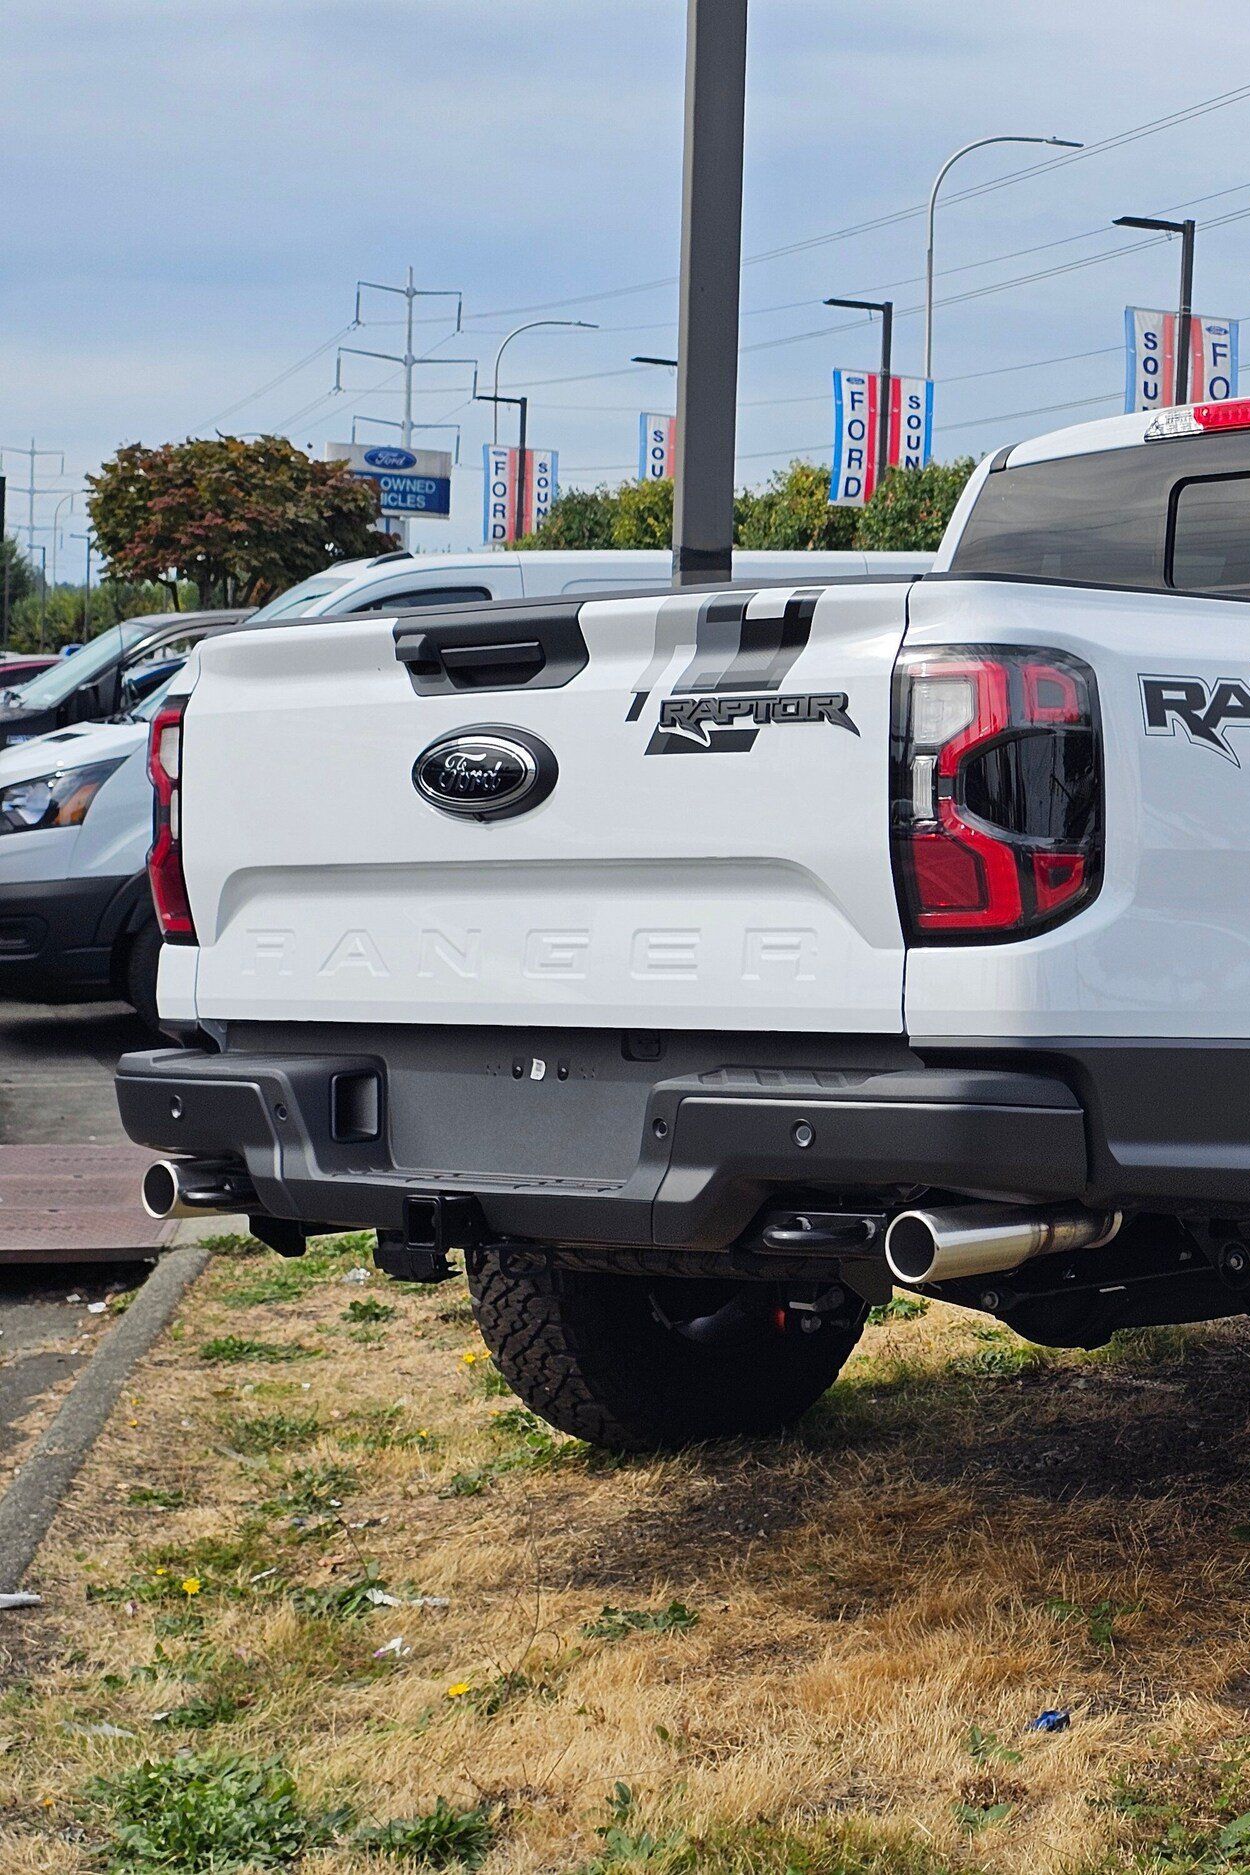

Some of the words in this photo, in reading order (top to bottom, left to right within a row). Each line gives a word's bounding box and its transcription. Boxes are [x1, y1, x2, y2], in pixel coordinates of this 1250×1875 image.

[1142, 332, 1158, 409] SOU
[1209, 342, 1230, 401] FO
[374, 451, 406, 466] Ford
[651, 430, 665, 478] SOU
[843, 391, 865, 498] FORD
[905, 395, 922, 470] SOUN
[380, 493, 426, 509] ICLES
[492, 461, 507, 540] FORD
[660, 691, 861, 742] RAPTOR
[438, 752, 503, 792] Ford
[241, 926, 820, 981] RANGER
